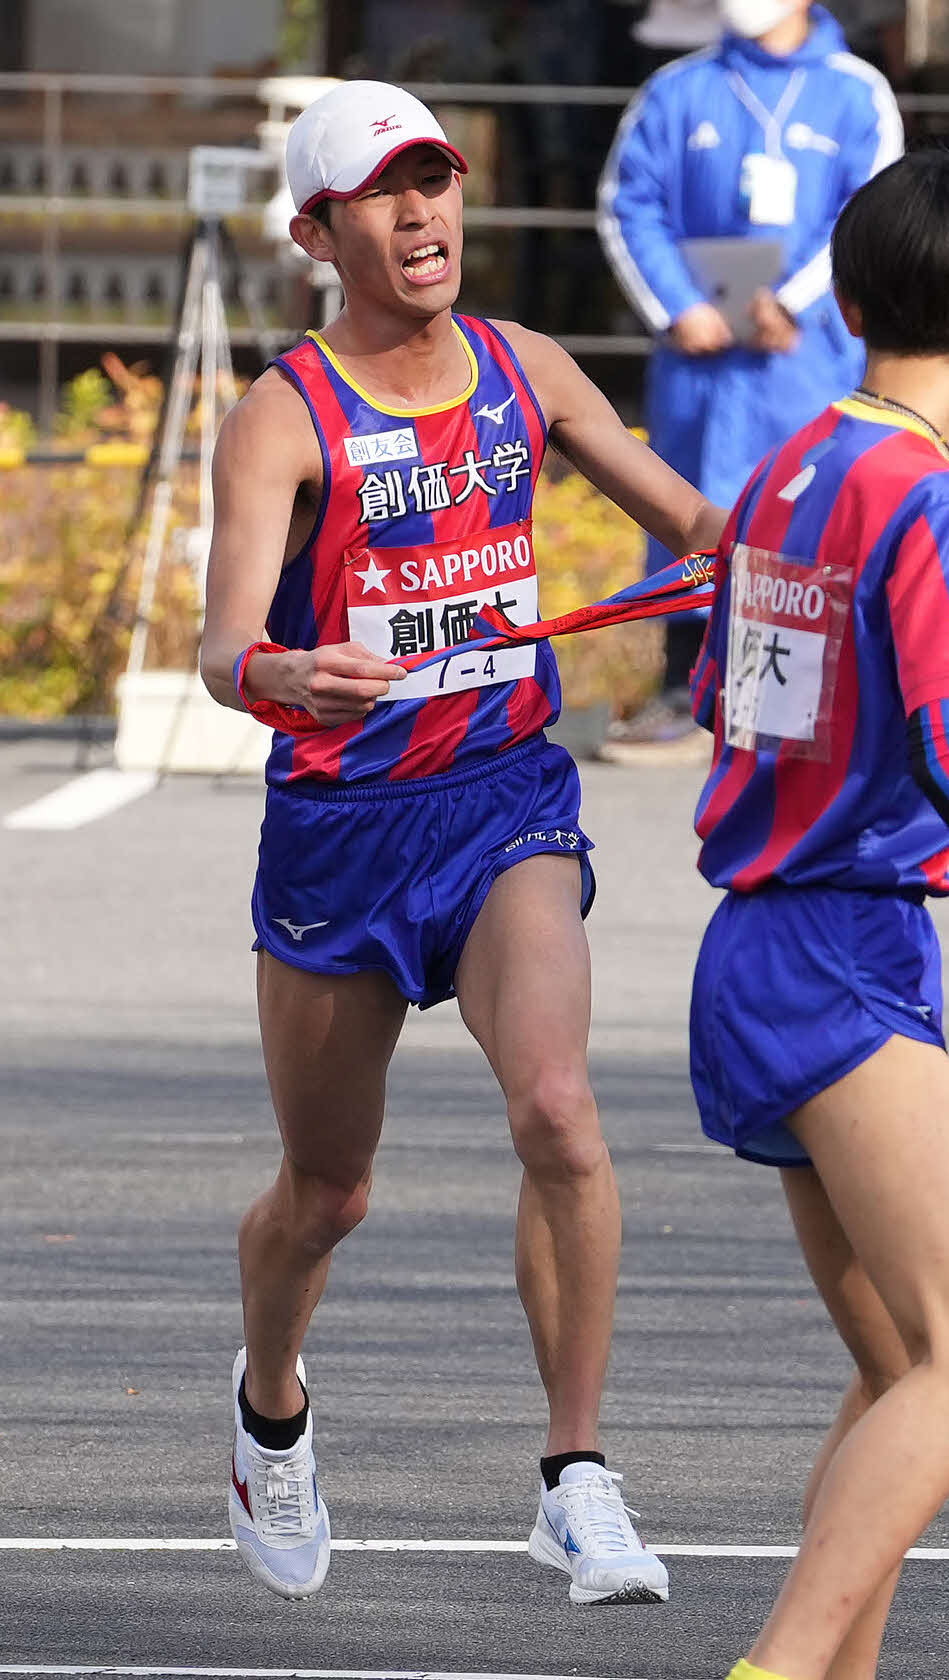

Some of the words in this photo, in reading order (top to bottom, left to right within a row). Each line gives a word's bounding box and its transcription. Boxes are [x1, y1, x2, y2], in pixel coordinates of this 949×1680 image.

[348, 433, 417, 462] 創友会
[357, 439, 532, 524] 創価大学
[399, 535, 531, 593] SAPPORO
[740, 571, 826, 620] APPORO
